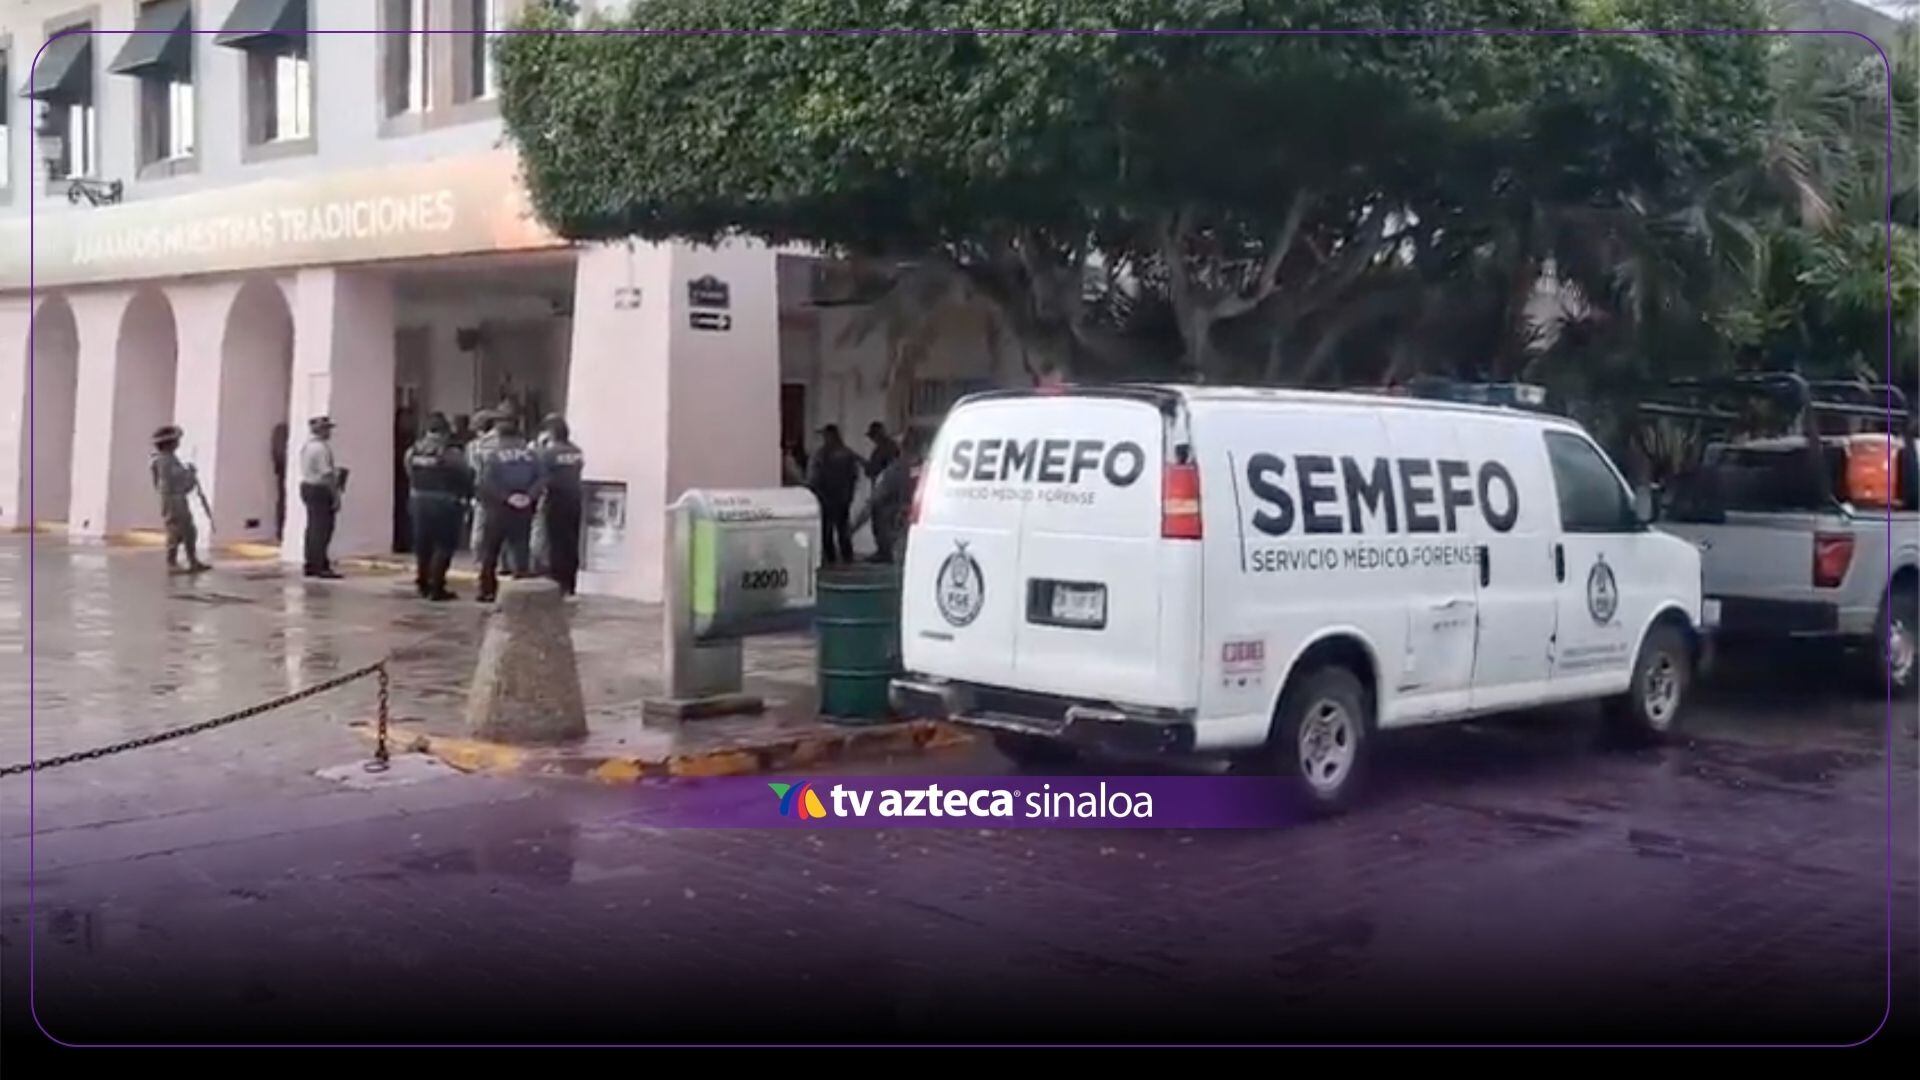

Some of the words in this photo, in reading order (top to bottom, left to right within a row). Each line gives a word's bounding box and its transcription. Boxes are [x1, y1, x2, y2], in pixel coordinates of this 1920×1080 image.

[163, 210, 275, 258] NUESTRAS
[280, 189, 456, 243] TRADICIONES
[947, 438, 1146, 488] SEMEFO
[945, 486, 988, 500] ICIO
[1038, 488, 1097, 505] FORENSE
[1246, 451, 1520, 537] SEMEFO
[1252, 547, 1338, 573] SERVICIO
[1344, 540, 1408, 569] MÉDICO
[1411, 545, 1484, 567] FORENSE
